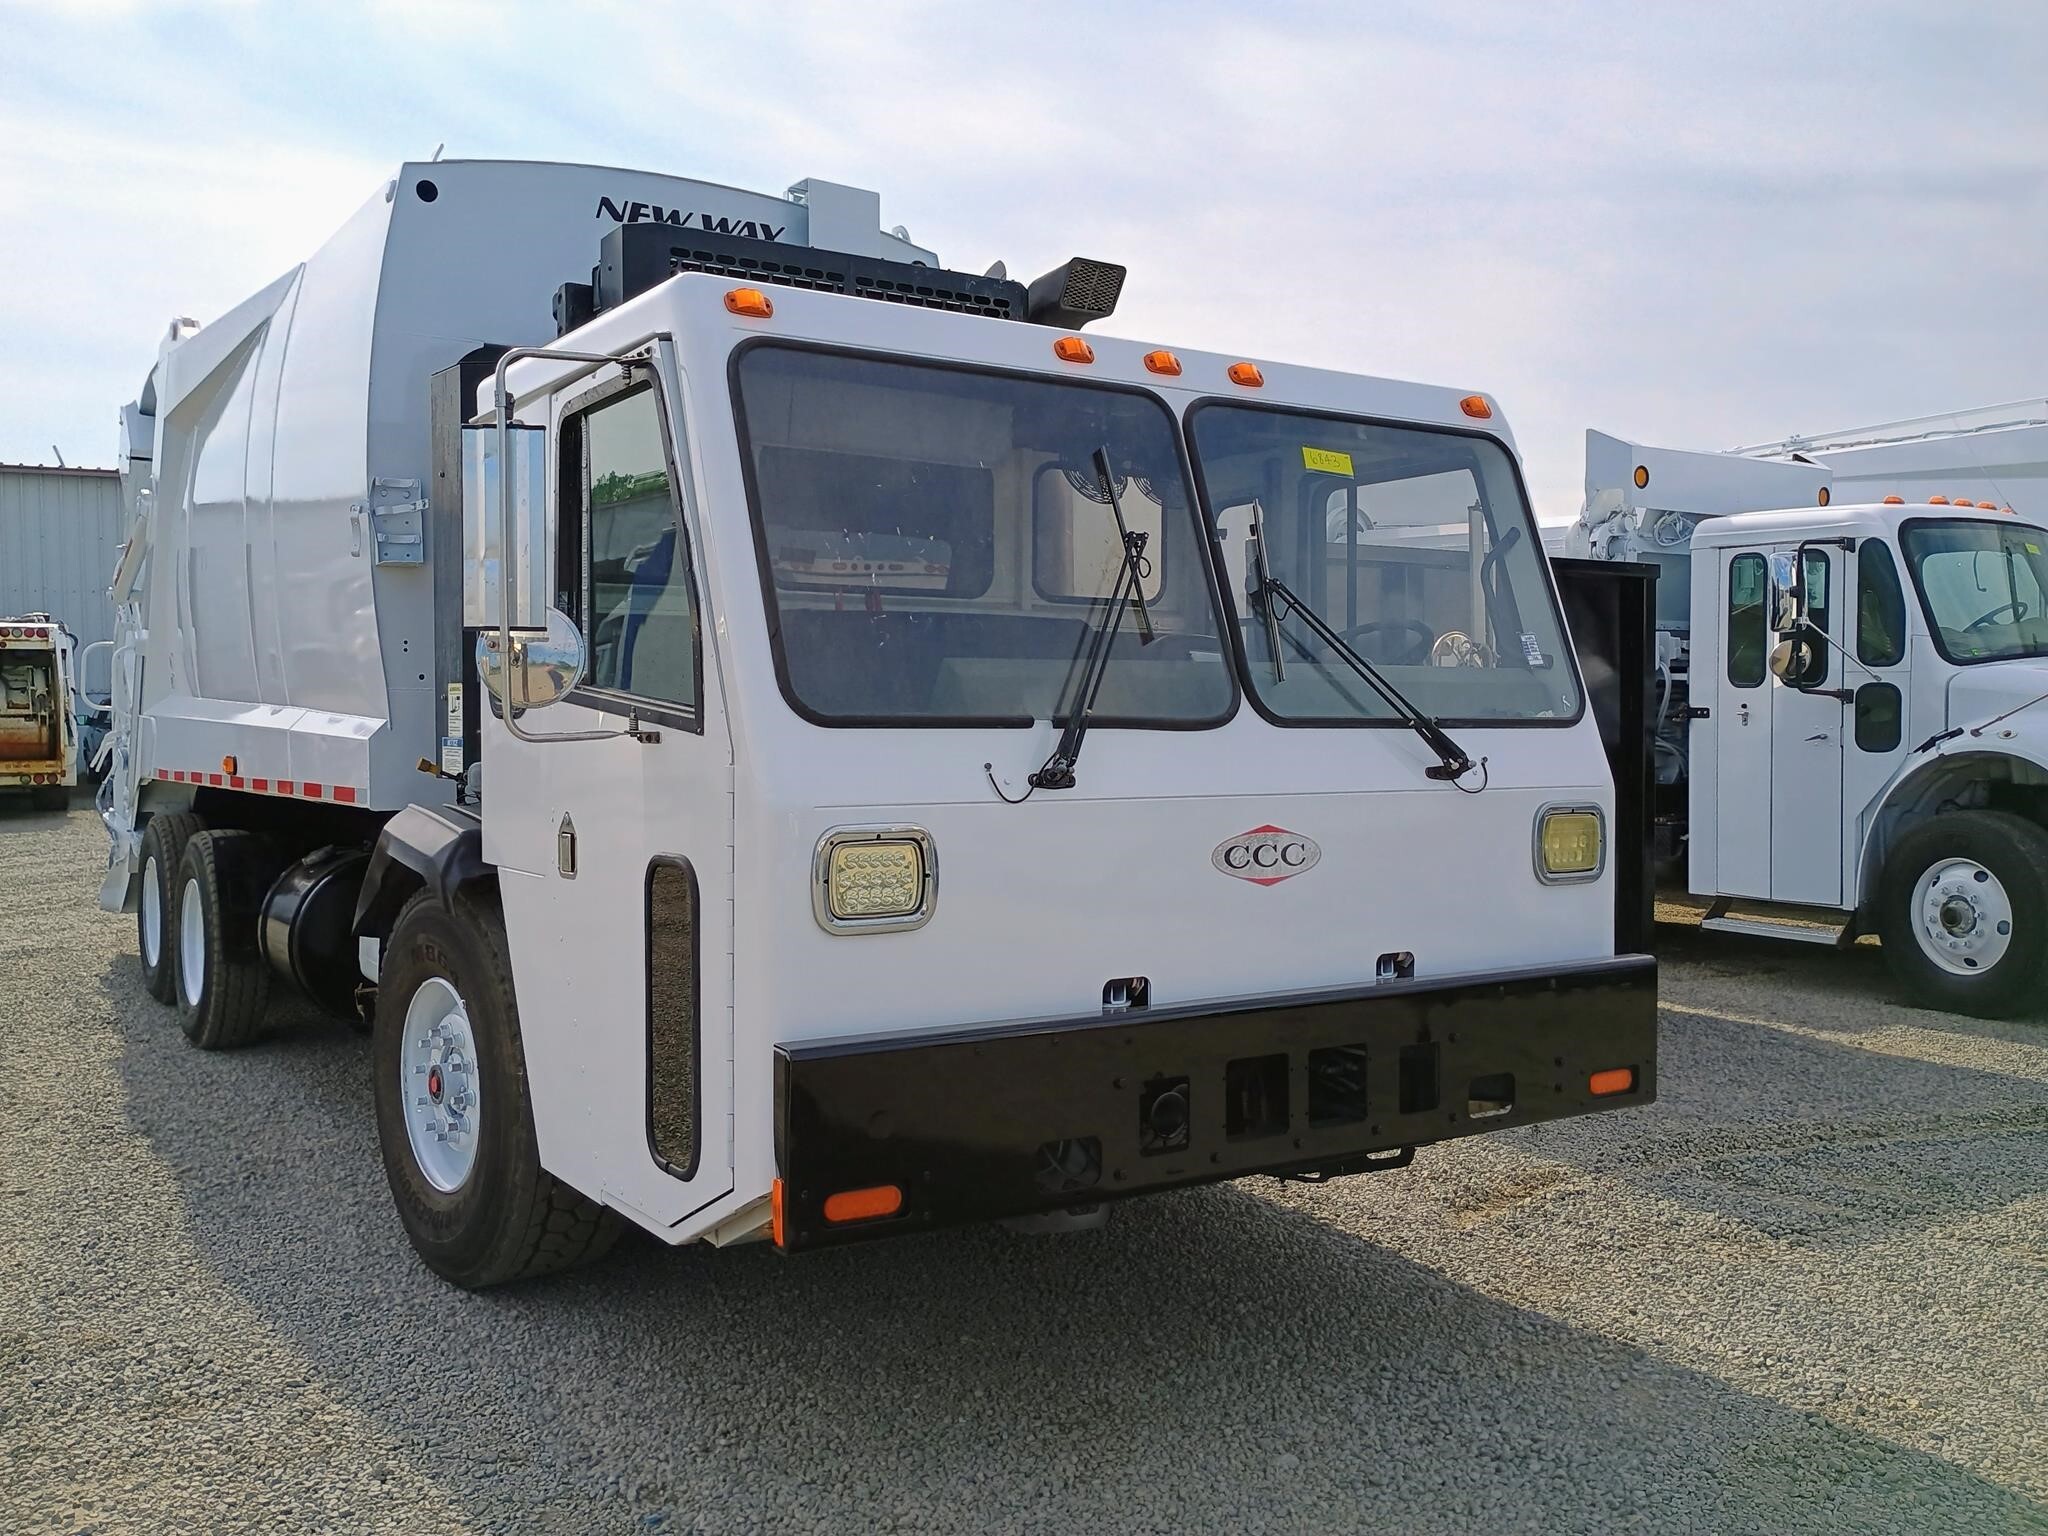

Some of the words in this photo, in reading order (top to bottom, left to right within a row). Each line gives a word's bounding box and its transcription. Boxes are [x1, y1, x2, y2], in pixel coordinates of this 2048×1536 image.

[596, 196, 694, 226] NEW
[701, 213, 786, 242] WAY
[1309, 450, 1341, 468] 6843
[1223, 842, 1307, 870] CCC
